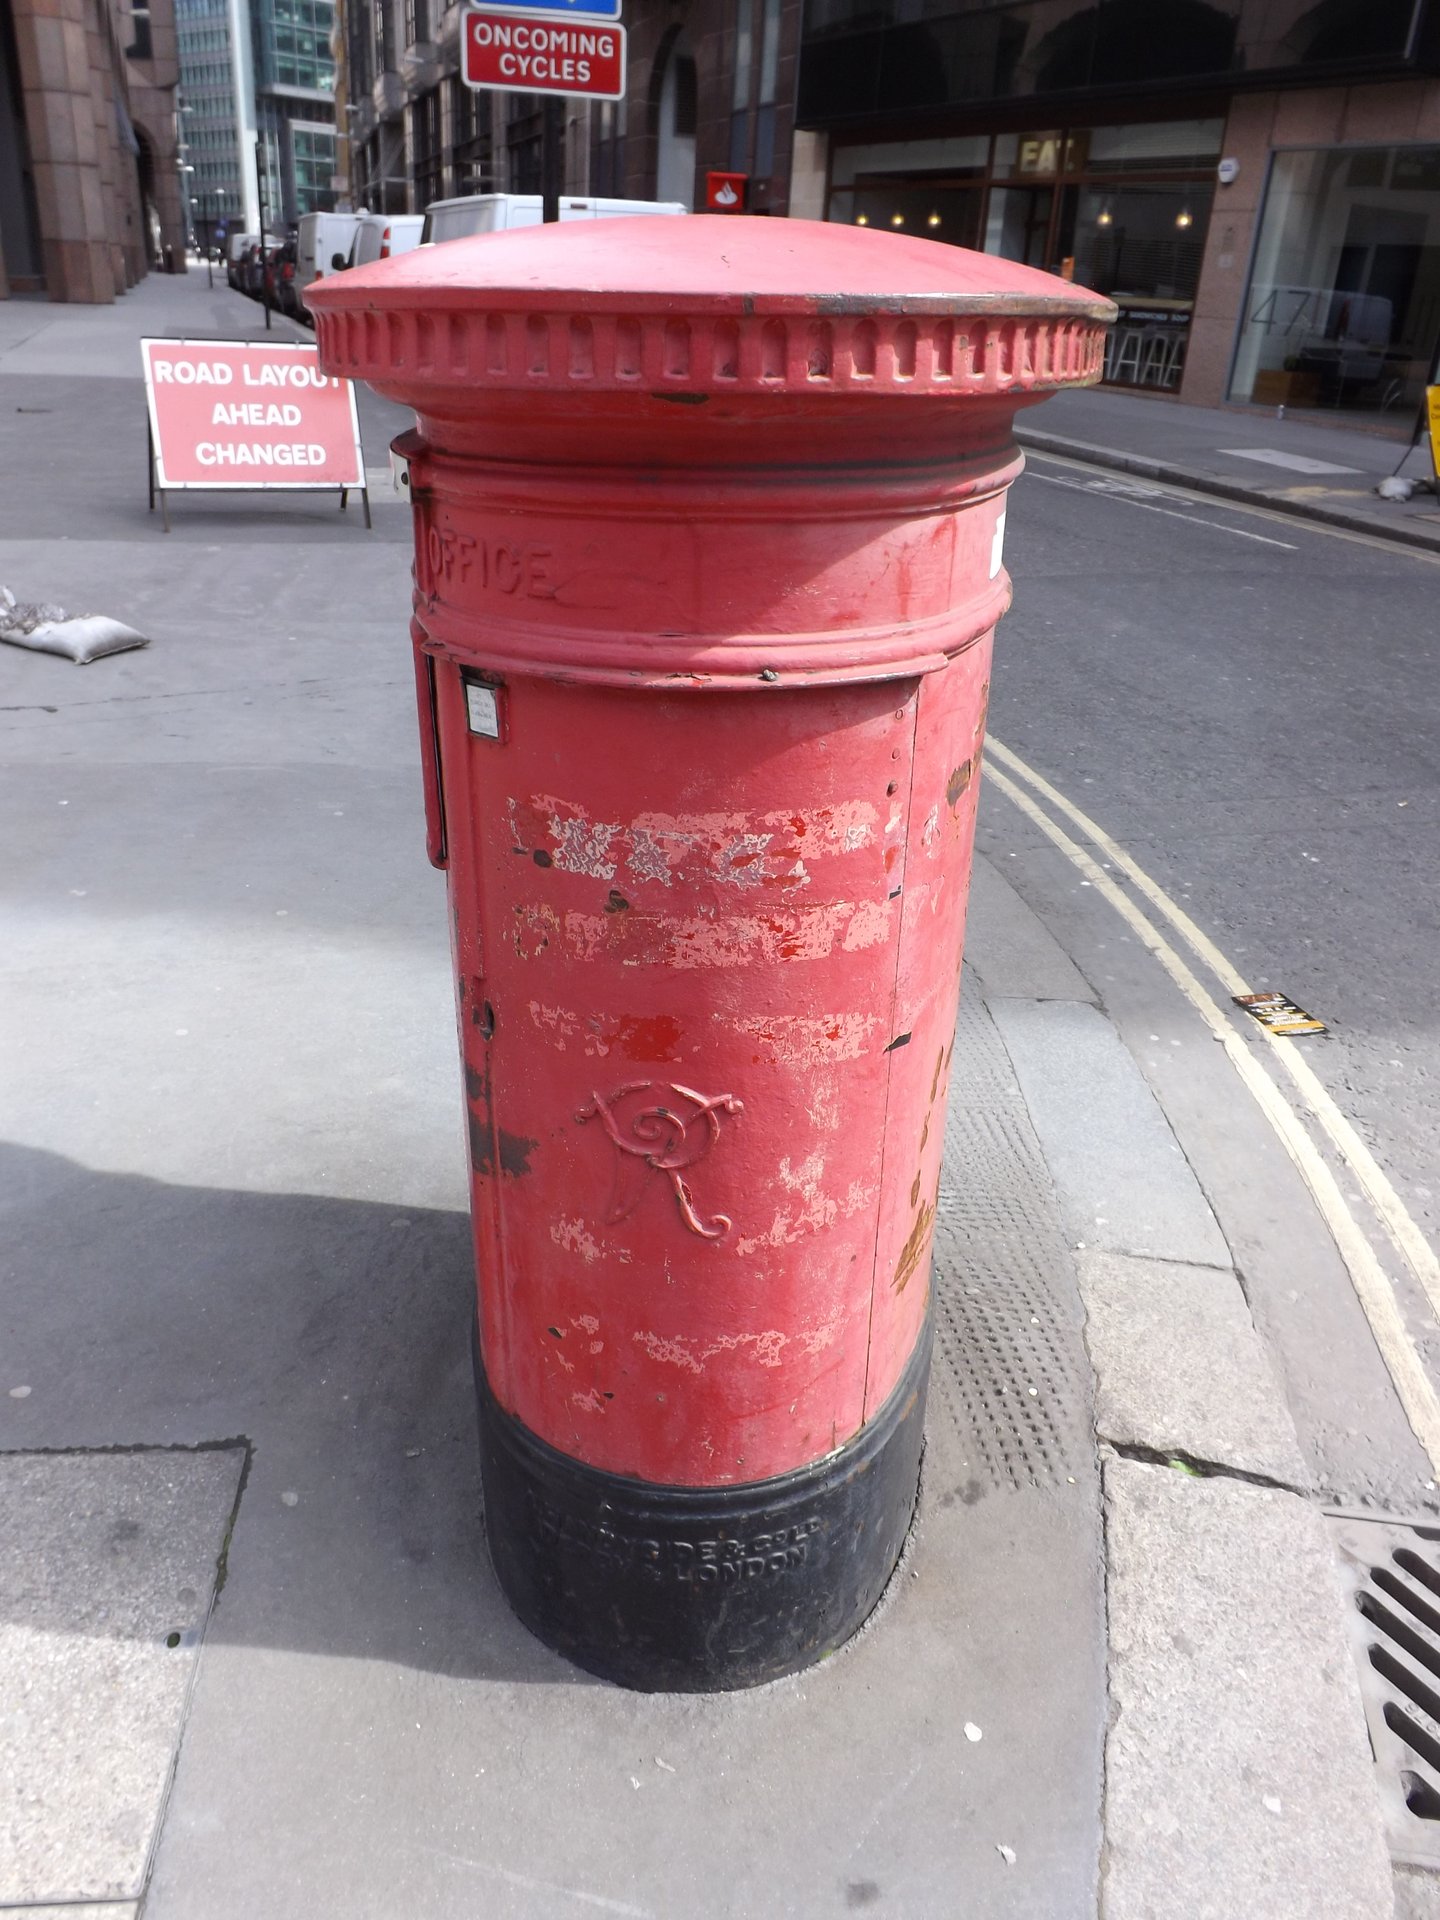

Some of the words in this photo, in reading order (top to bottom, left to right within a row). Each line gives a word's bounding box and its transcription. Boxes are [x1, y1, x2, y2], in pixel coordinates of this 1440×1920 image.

[474, 22, 614, 58] ONCOMING
[500, 53, 591, 82] CYCLES
[1251, 289, 1311, 336] 47
[154, 360, 233, 385] ROAD
[212, 402, 302, 426] AHEAD
[195, 442, 327, 466] CHANGED
[428, 525, 557, 600] OFFICE
[673, 1543, 808, 1582] LONDON
